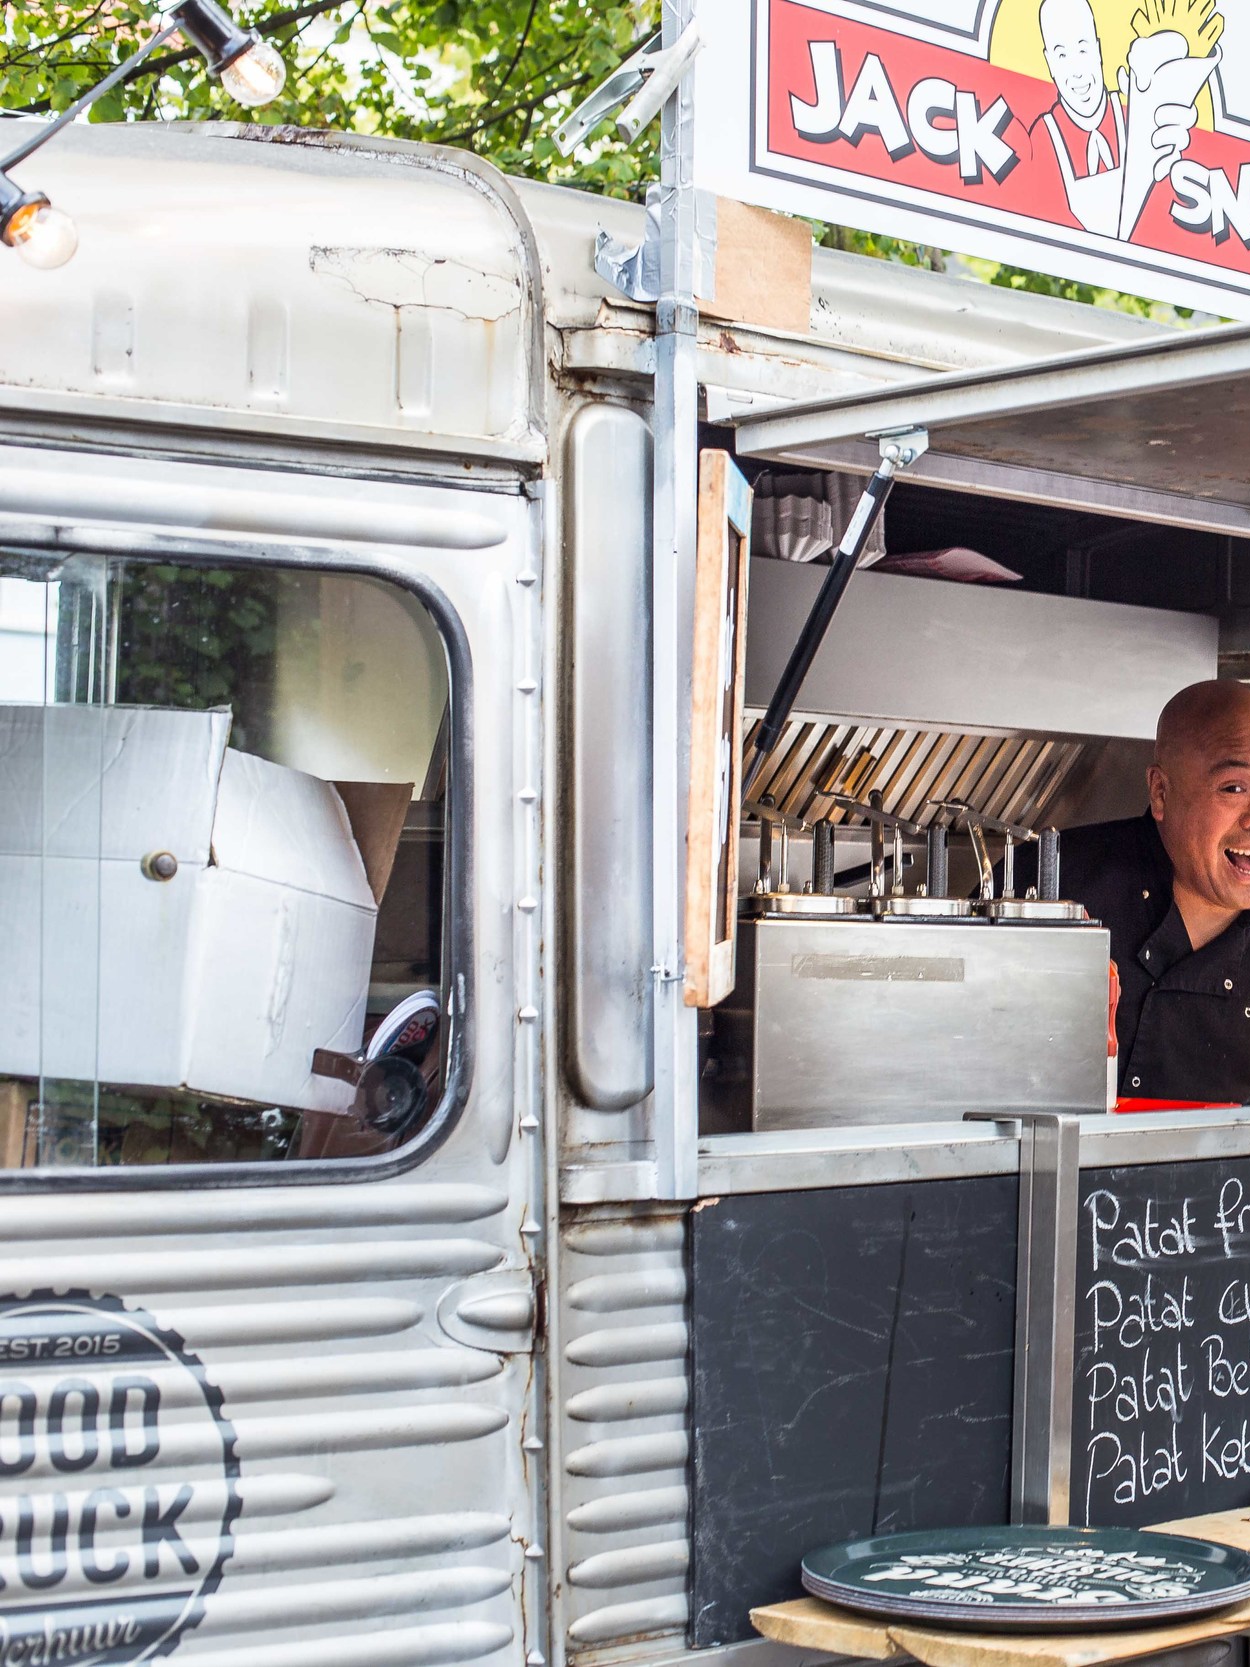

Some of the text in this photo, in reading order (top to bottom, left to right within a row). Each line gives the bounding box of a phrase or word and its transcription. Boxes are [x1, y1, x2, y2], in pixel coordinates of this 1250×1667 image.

[789, 41, 1020, 184] JACK
[1084, 1189, 1196, 1271] Patat
[53, 1334, 121, 1357] 2015
[1085, 1274, 1195, 1355] Patat
[1085, 1343, 1195, 1430] Patat
[1085, 1422, 1188, 1530] Patat
[0, 1483, 200, 1591] UCK
[0, 1613, 143, 1667] erhuur
